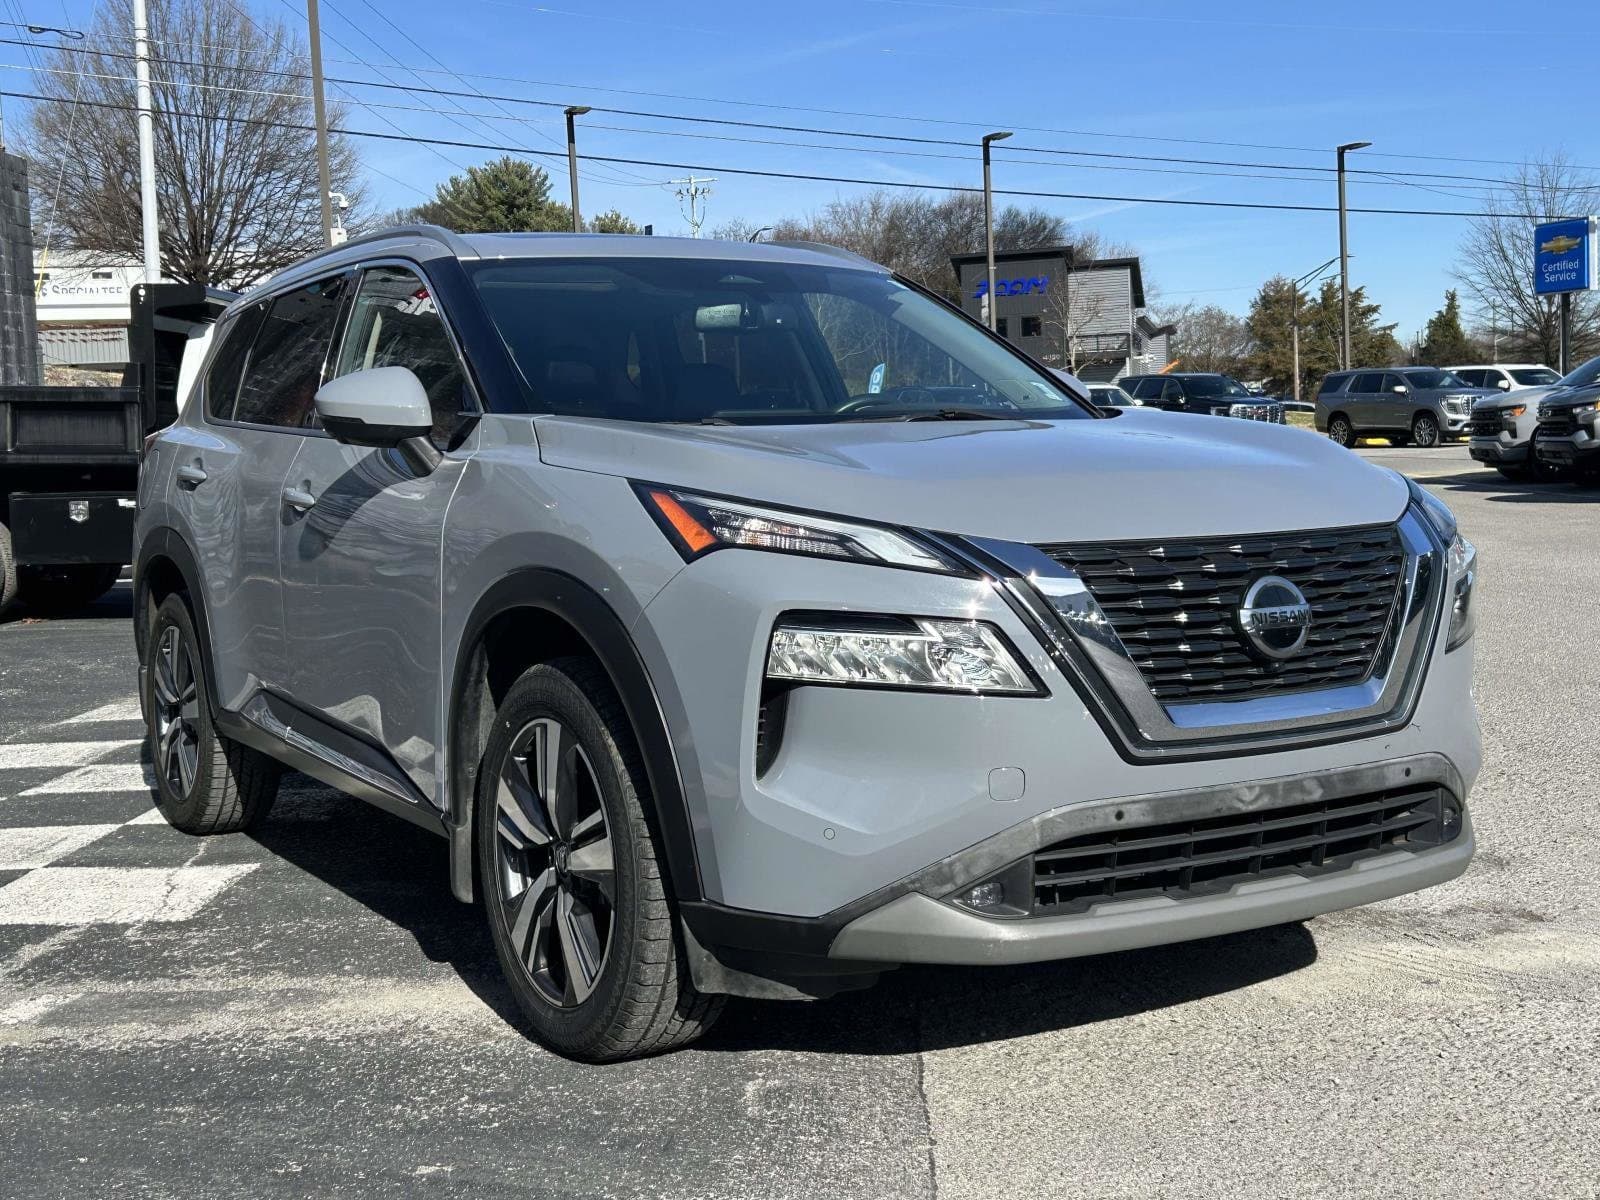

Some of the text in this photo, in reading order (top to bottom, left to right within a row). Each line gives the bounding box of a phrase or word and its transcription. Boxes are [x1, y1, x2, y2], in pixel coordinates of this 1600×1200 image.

[1541, 259, 1579, 273] Certified
[1544, 271, 1577, 282] Service
[1250, 607, 1309, 626] NISSAN
